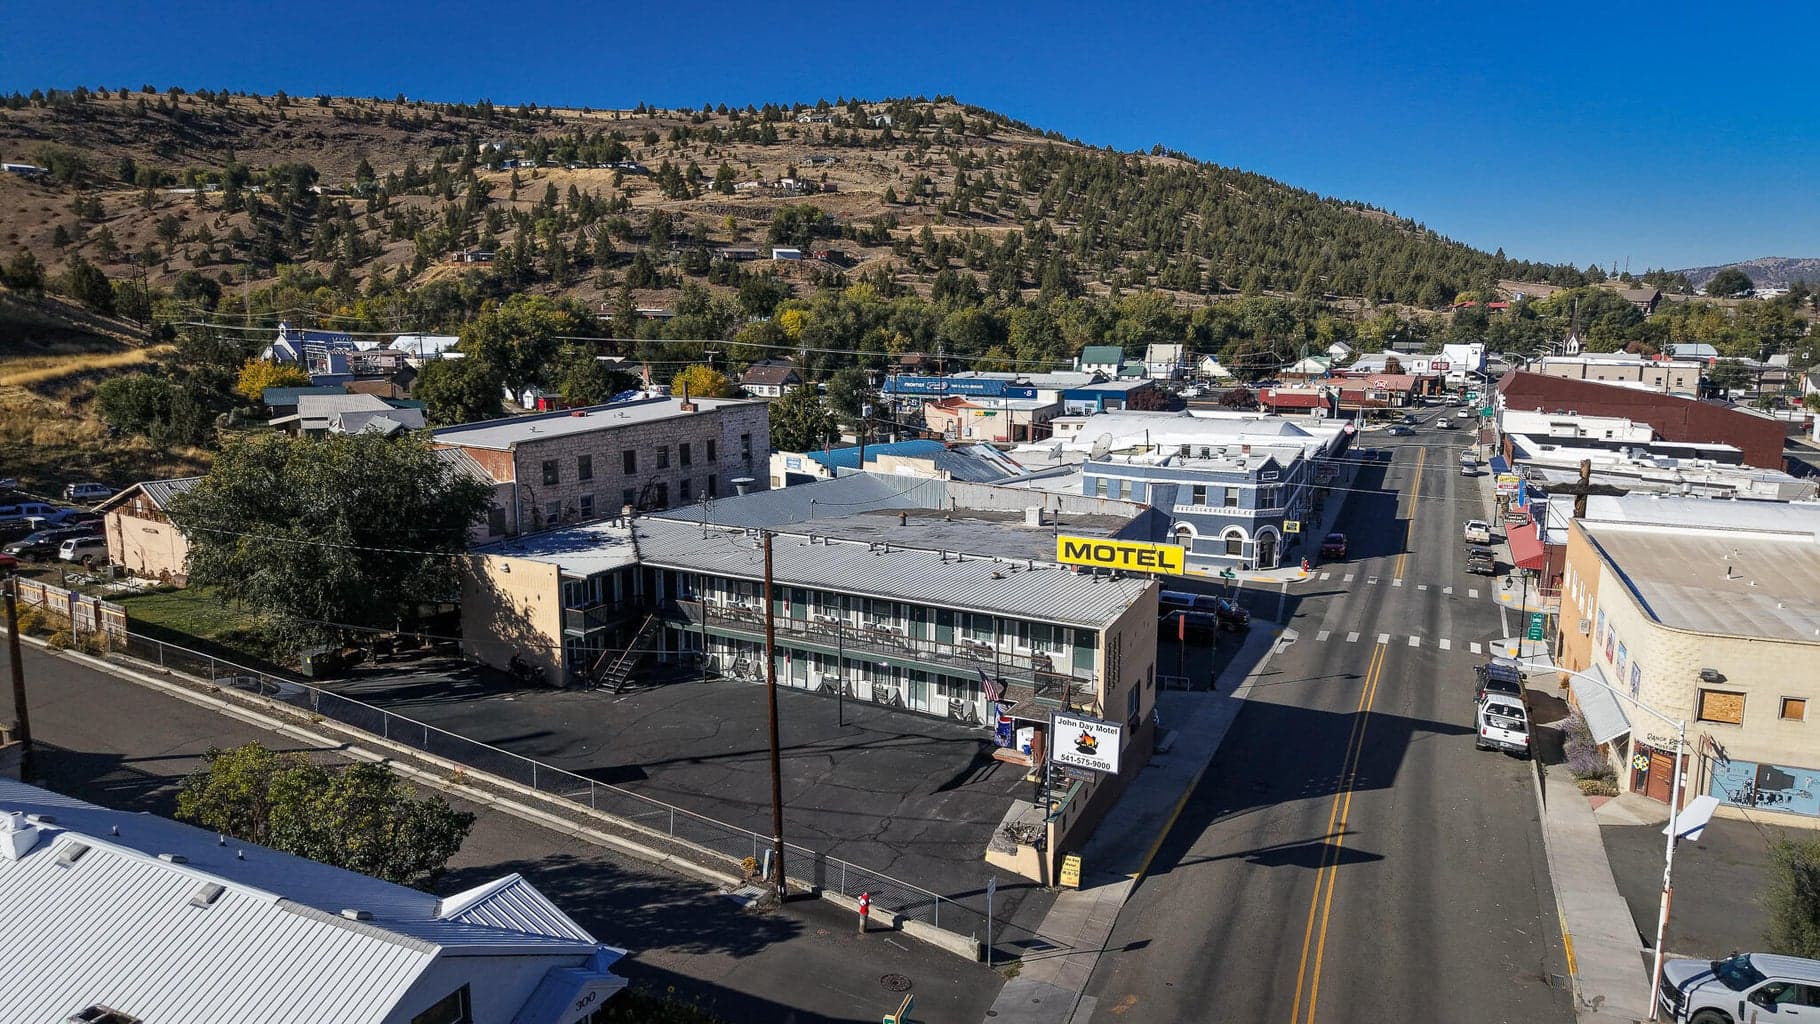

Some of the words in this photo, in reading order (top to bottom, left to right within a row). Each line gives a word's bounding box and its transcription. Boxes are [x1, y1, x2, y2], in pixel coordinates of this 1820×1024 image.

[1064, 541, 1175, 569] MOTEL
[1057, 718, 1077, 728] John
[1079, 721, 1094, 732] Day
[1095, 725, 1118, 735] Motel
[1060, 753, 1111, 770] 541-575-9000
[575, 991, 596, 1011] 300
